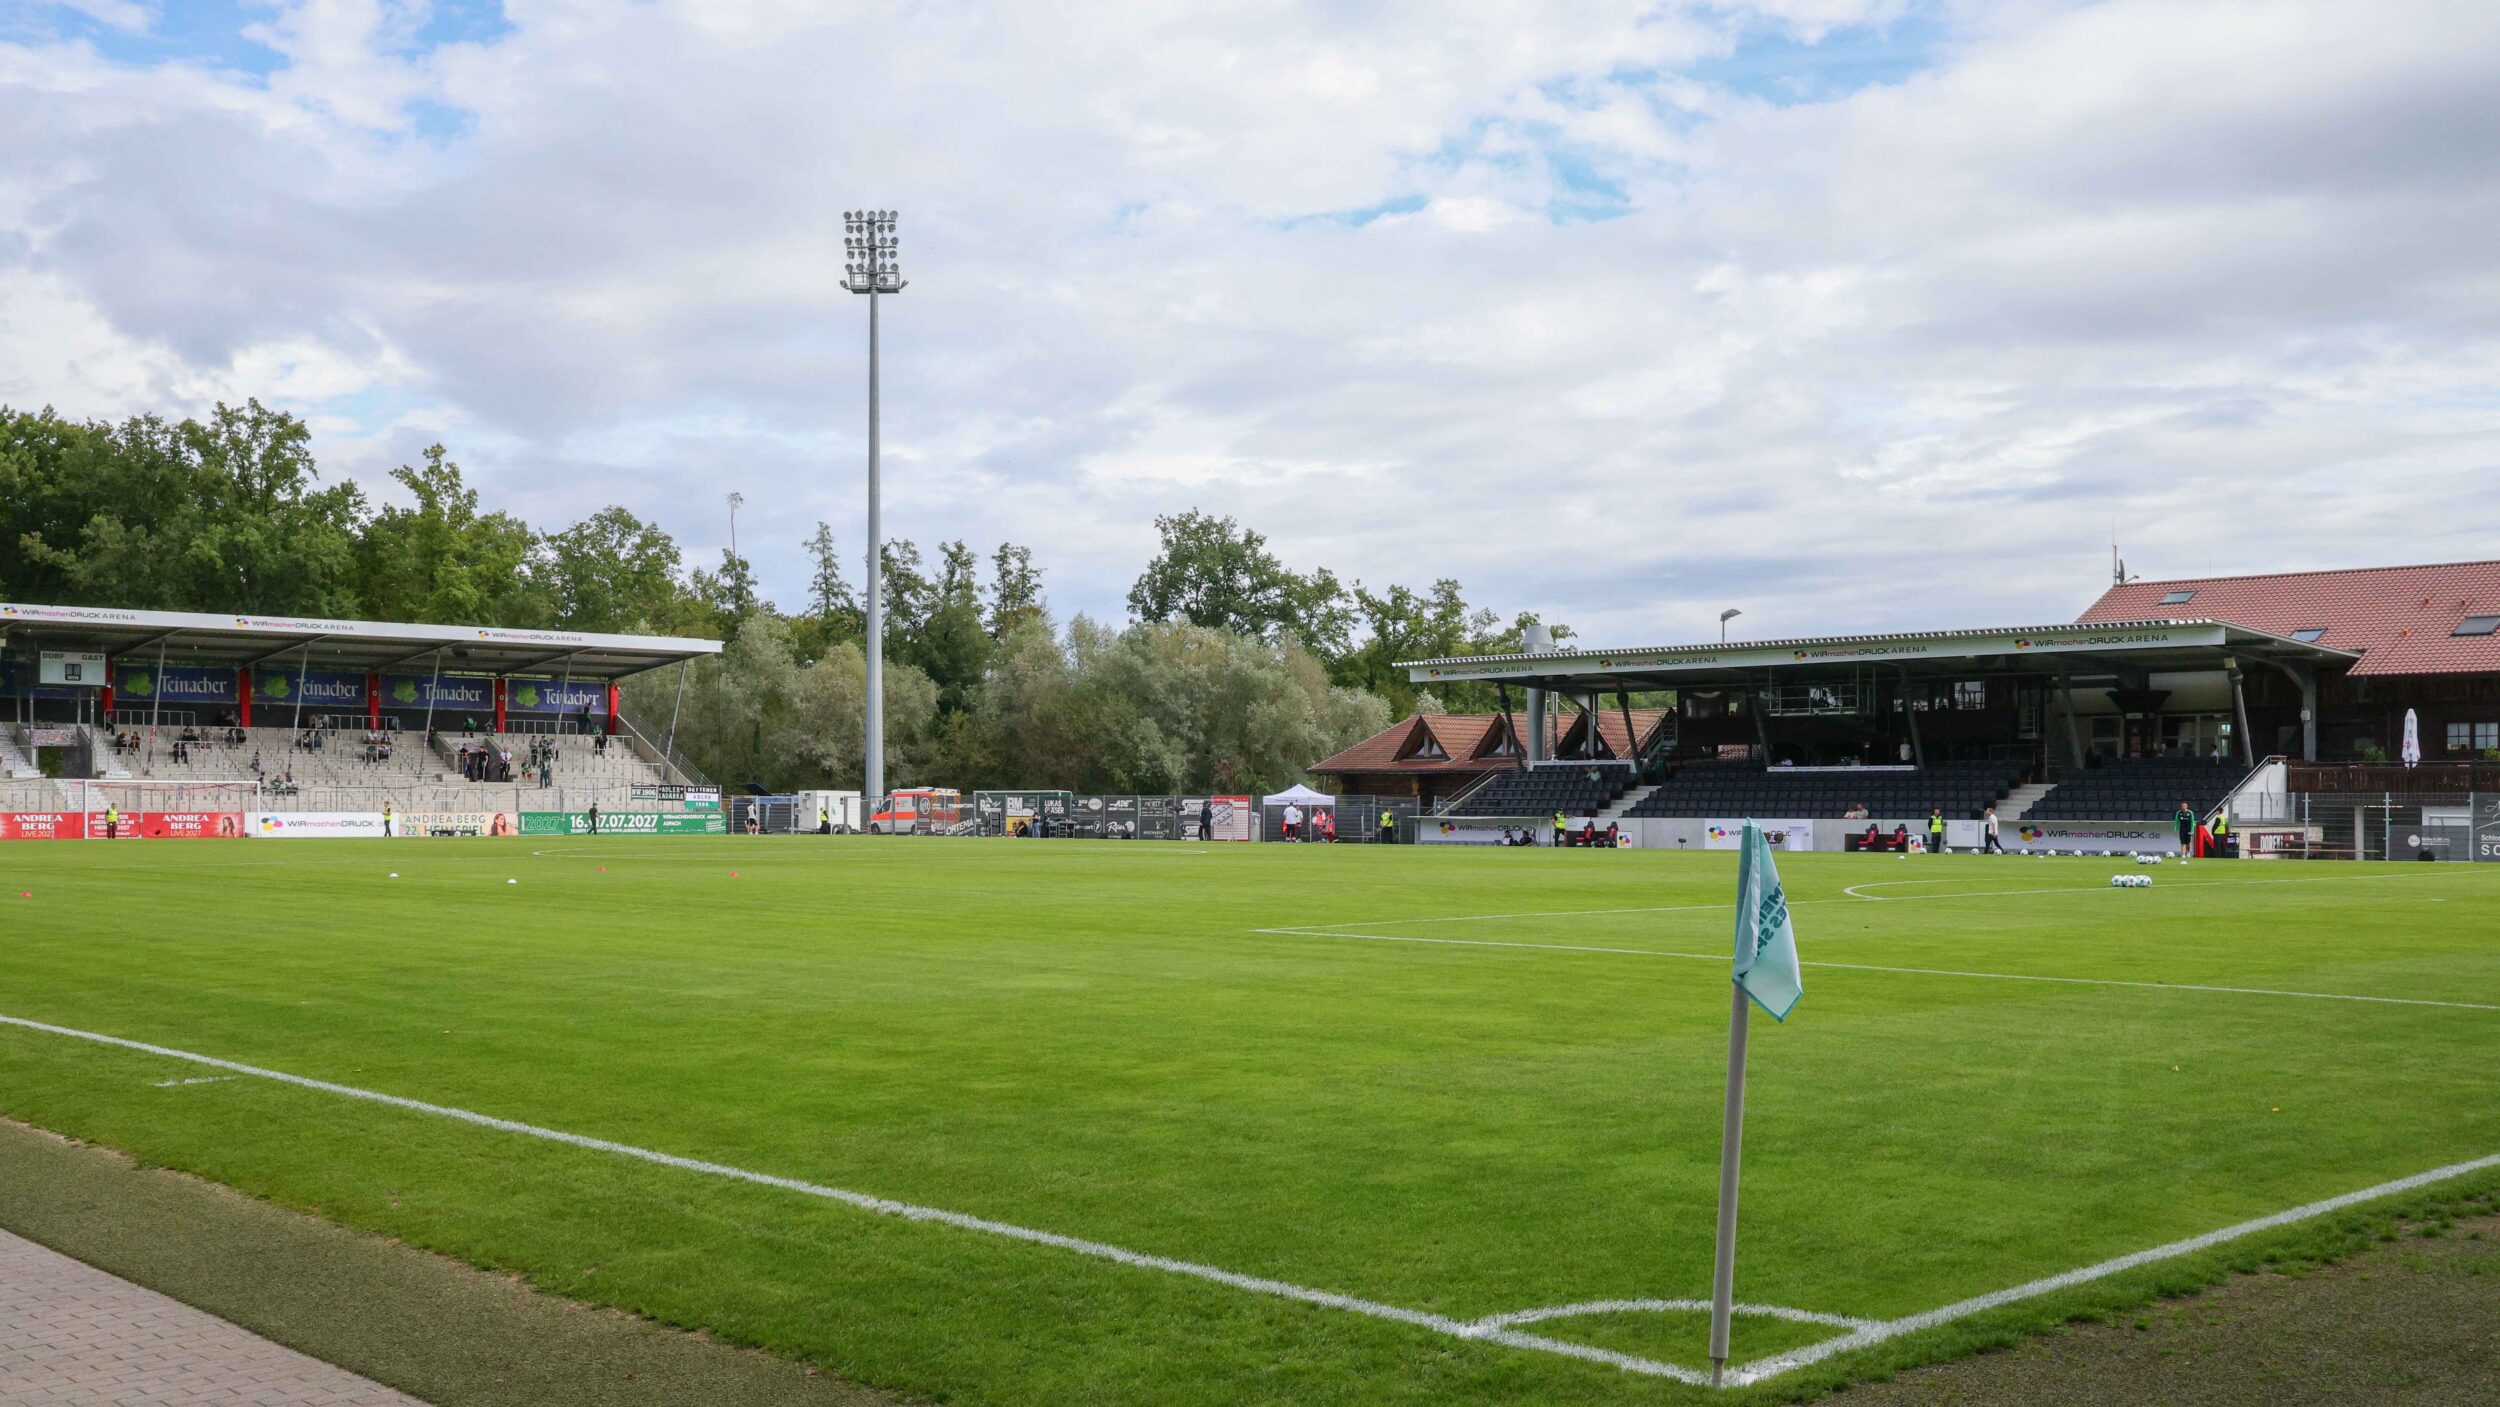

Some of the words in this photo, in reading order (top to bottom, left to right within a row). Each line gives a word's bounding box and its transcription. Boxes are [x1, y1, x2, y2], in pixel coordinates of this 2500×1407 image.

[324, 623, 354, 631] ARENA
[2034, 636, 2125, 647] WIRmachenDRUCK
[2127, 634, 2169, 642] ARENA
[1892, 645, 1928, 654] ARENA
[1685, 656, 1718, 665] ARENA
[13, 814, 63, 822] ANDREA
[163, 814, 209, 822] ANDREA
[405, 815, 455, 824] ANDREA
[457, 815, 486, 824] BERG
[526, 816, 561, 831] 2027
[2047, 830, 2144, 839] WIRmachenDRUCK
